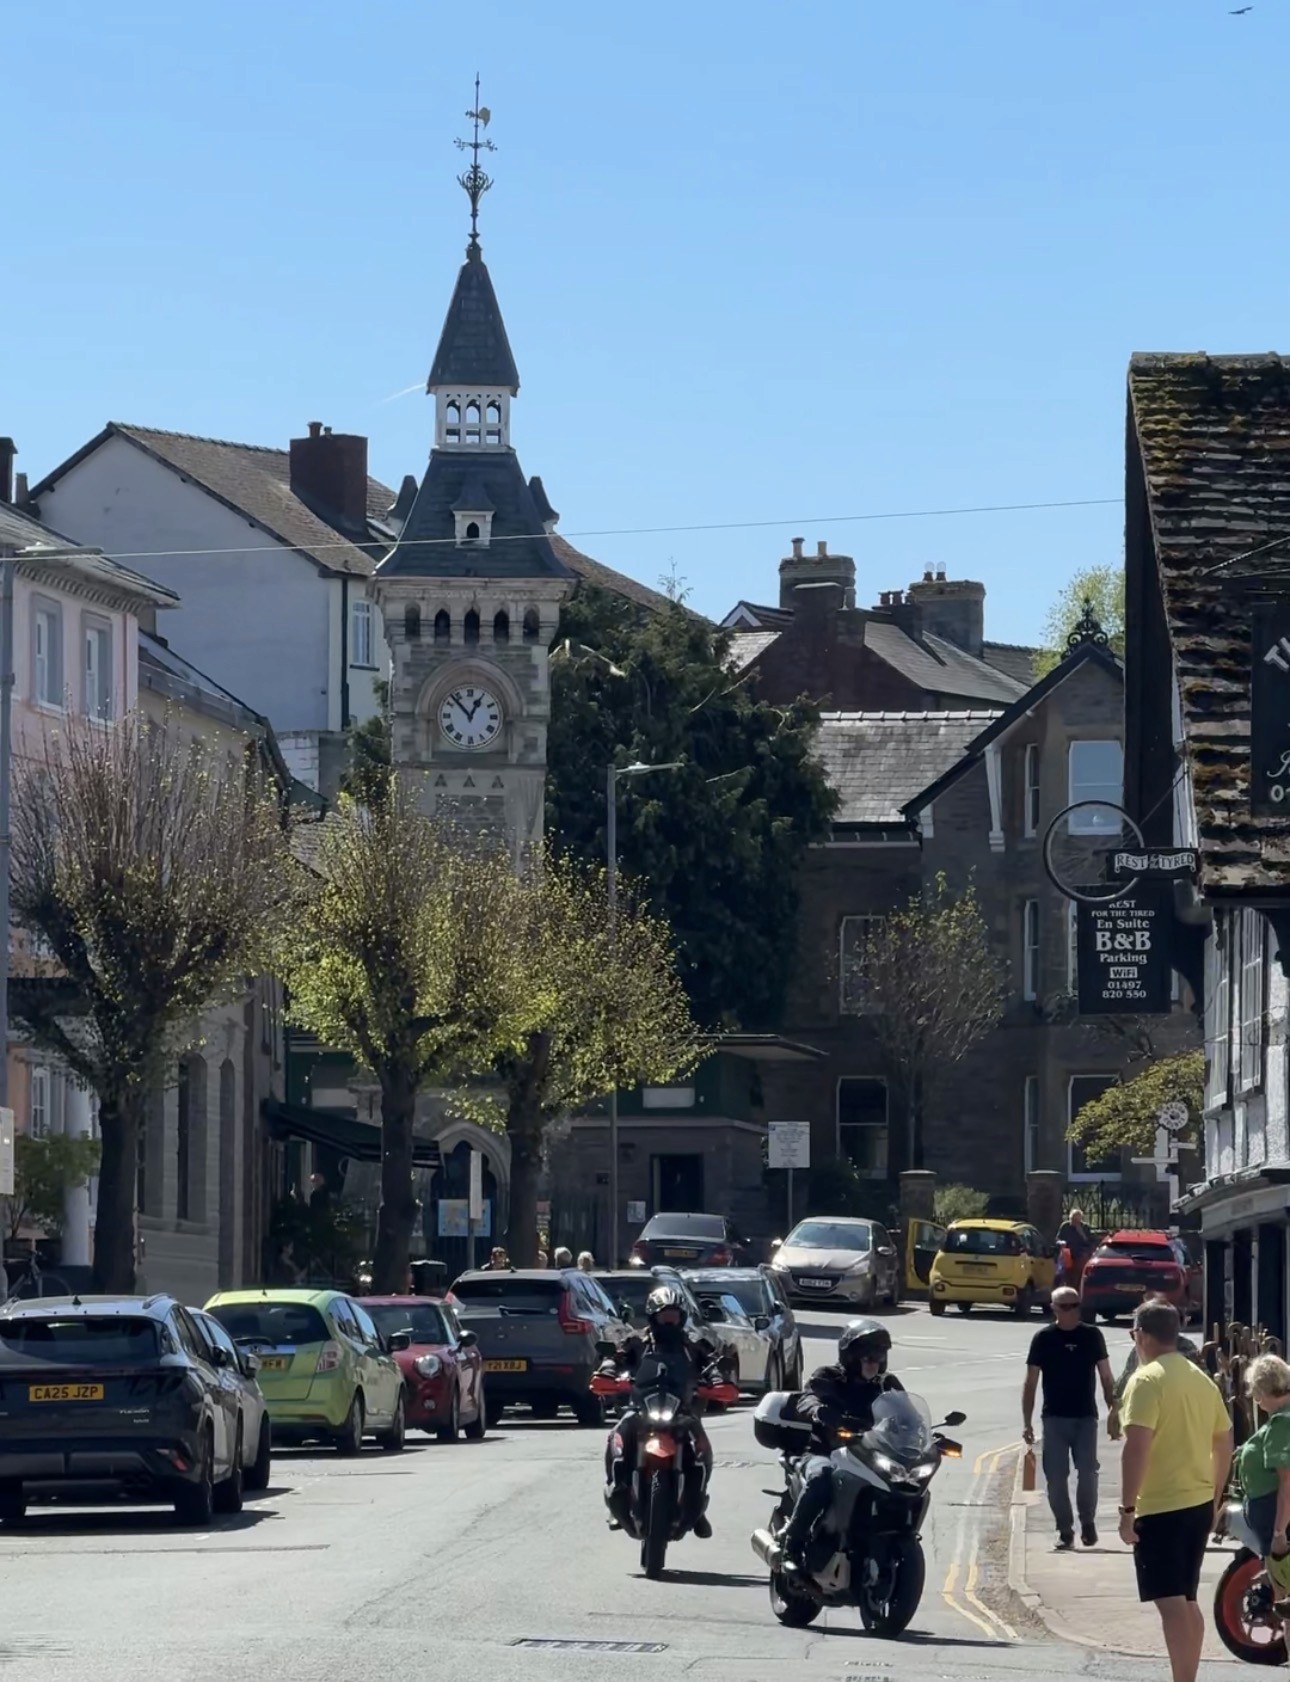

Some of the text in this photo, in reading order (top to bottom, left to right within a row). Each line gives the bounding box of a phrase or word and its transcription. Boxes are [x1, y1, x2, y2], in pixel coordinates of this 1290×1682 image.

[1117, 854, 1147, 868] REST
[1160, 853, 1194, 868] TYRED
[1097, 918, 1150, 929] En Suite
[1096, 931, 1151, 951] B&B
[1100, 952, 1148, 965] Parking
[1107, 981, 1142, 989] 01497
[1102, 990, 1147, 999] 820 550
[34, 1386, 99, 1400] CA25 JZP
